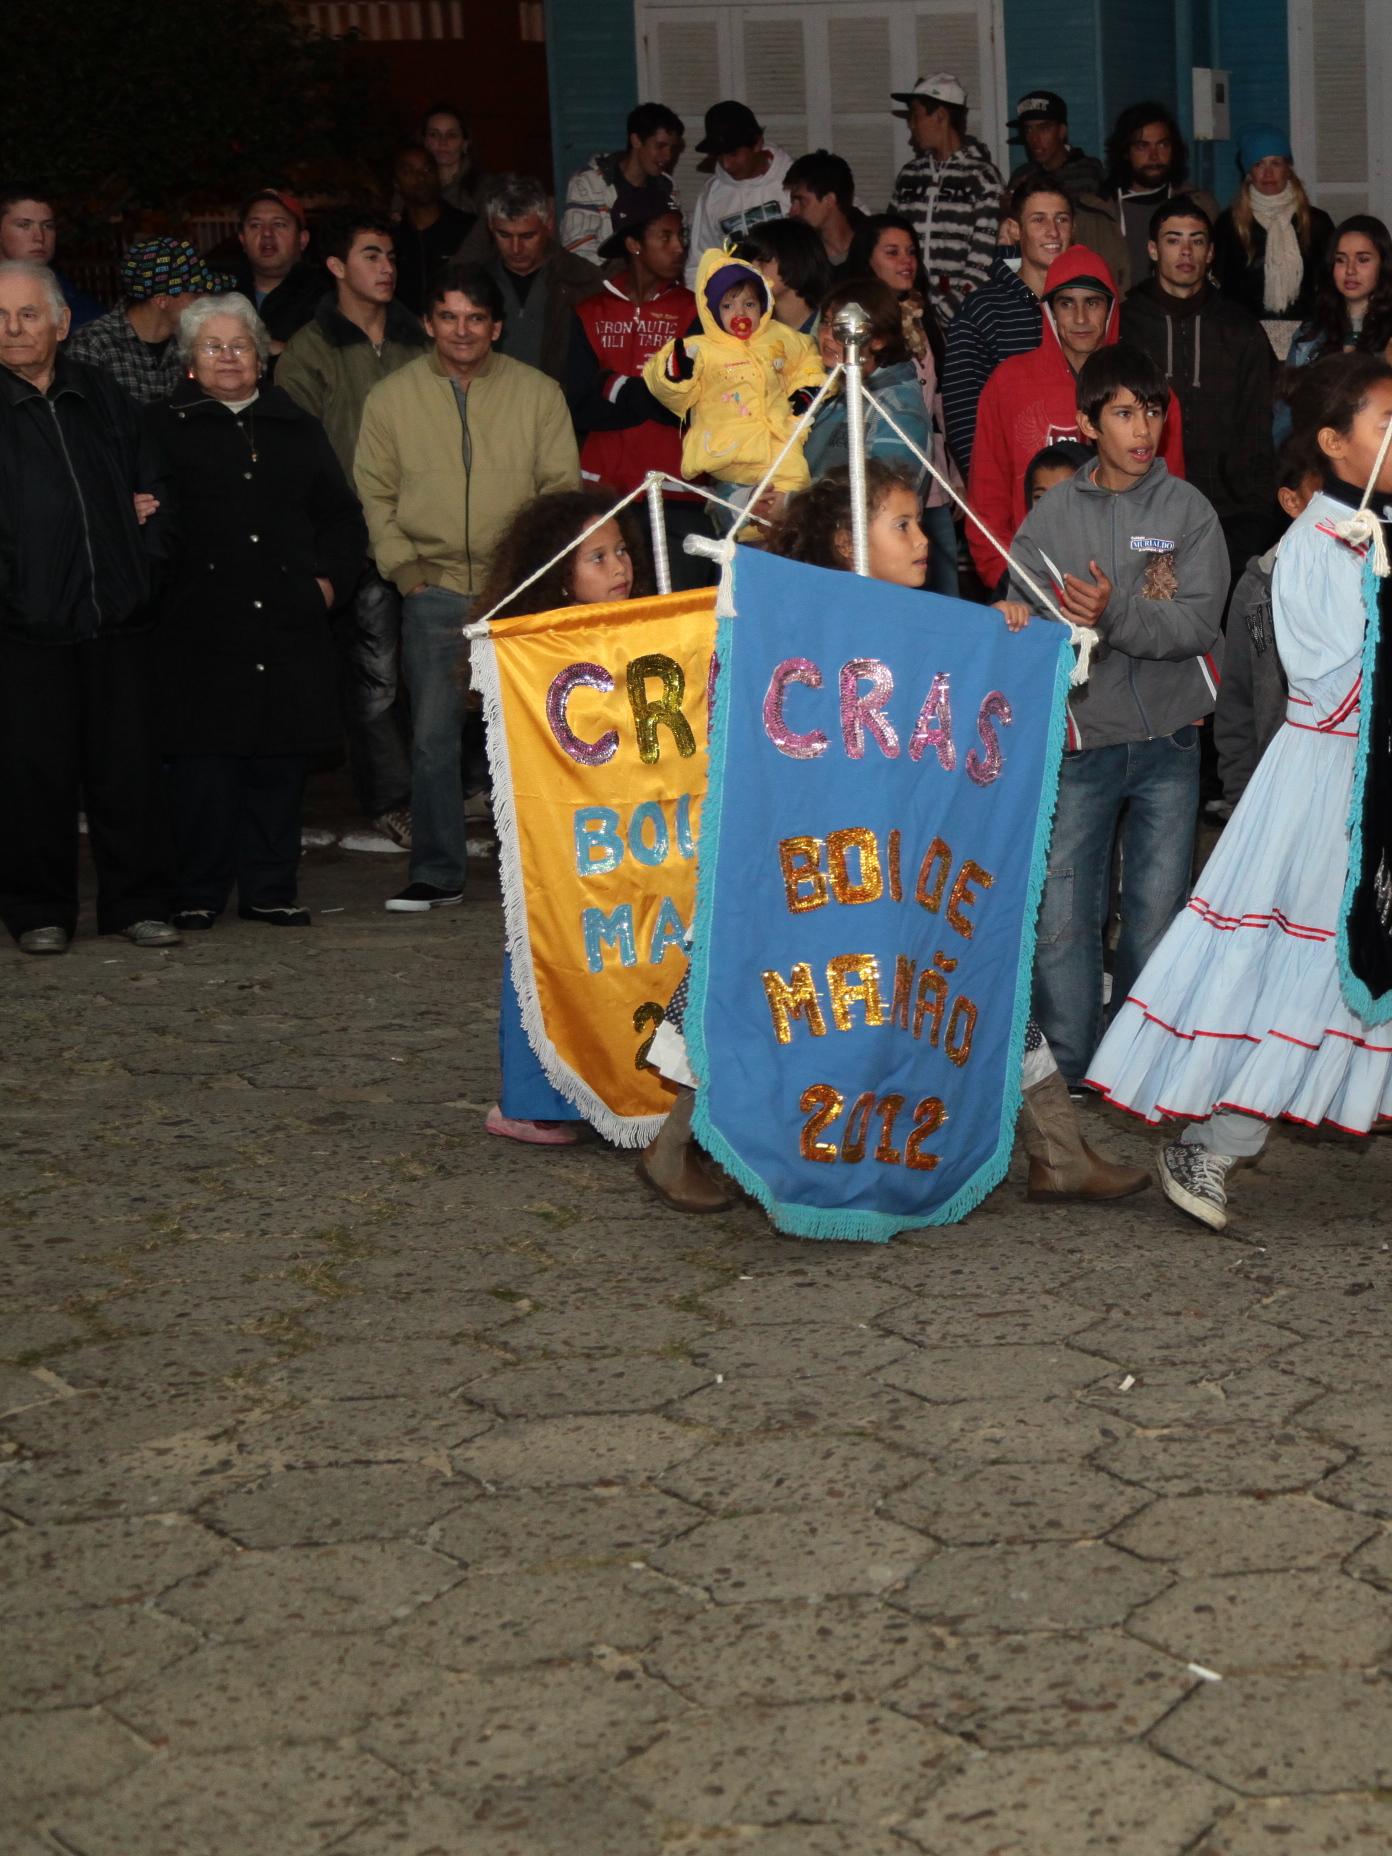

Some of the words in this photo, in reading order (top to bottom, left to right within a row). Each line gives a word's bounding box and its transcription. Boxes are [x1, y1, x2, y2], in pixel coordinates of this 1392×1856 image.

[1133, 540, 1173, 550] MURIALDO
[546, 653, 718, 766] CR
[763, 657, 1013, 787] CRAS
[574, 793, 695, 877] BOI
[778, 826, 904, 914] BOI
[914, 836, 994, 940] DE
[800, 1083, 945, 1171] 2012
